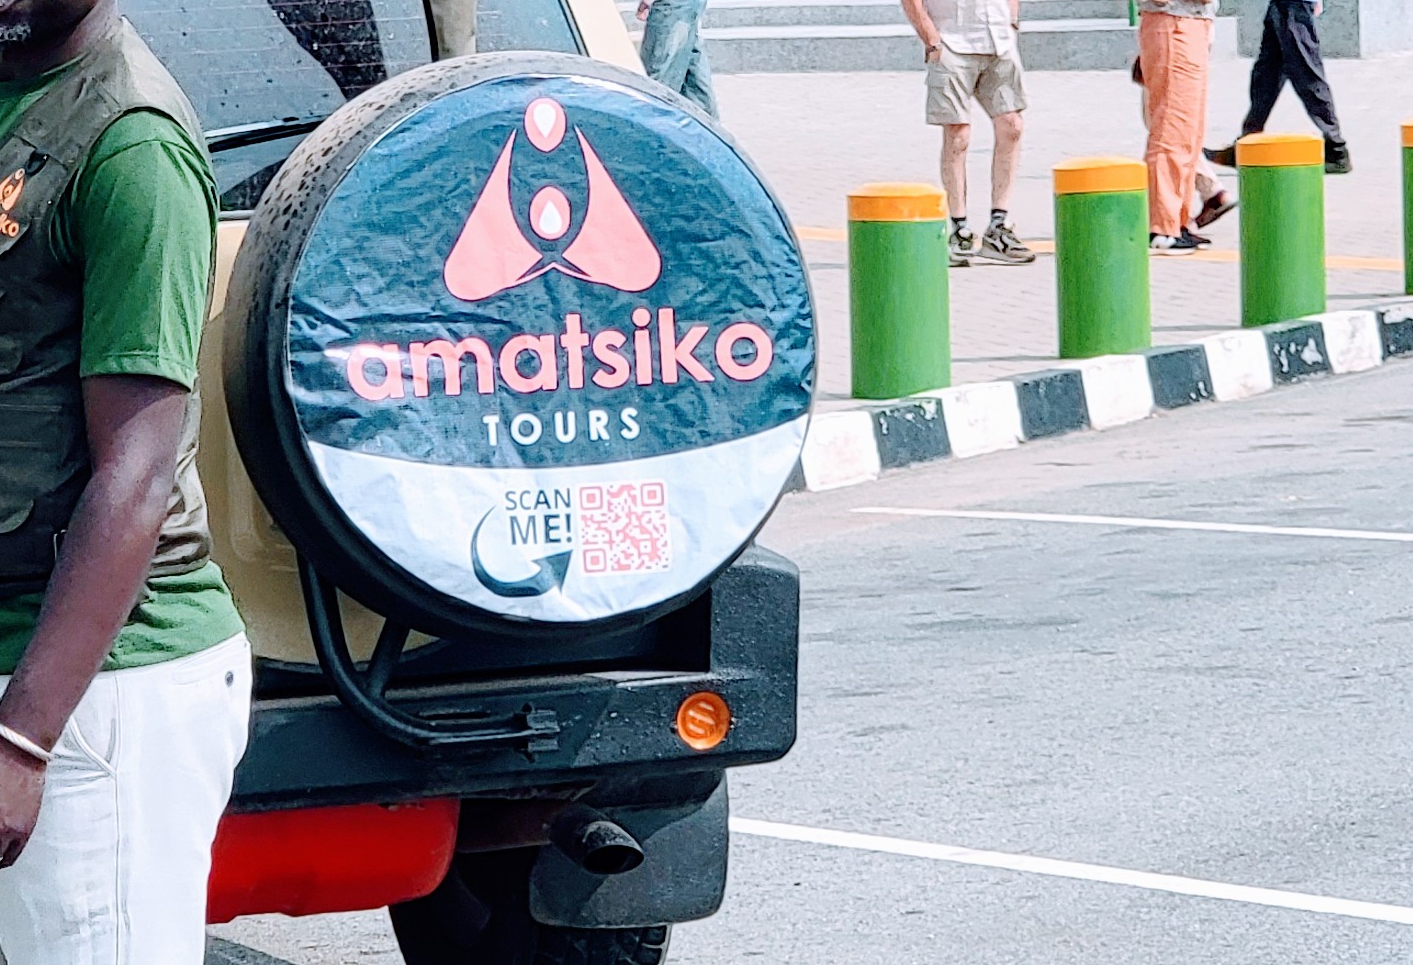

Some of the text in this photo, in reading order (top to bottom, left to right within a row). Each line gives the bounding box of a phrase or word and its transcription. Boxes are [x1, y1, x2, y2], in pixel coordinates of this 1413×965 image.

[345, 306, 774, 402] amatsiko
[482, 407, 641, 447] TOURS
[504, 487, 572, 511] SCAN
[509, 513, 573, 546] ME!
